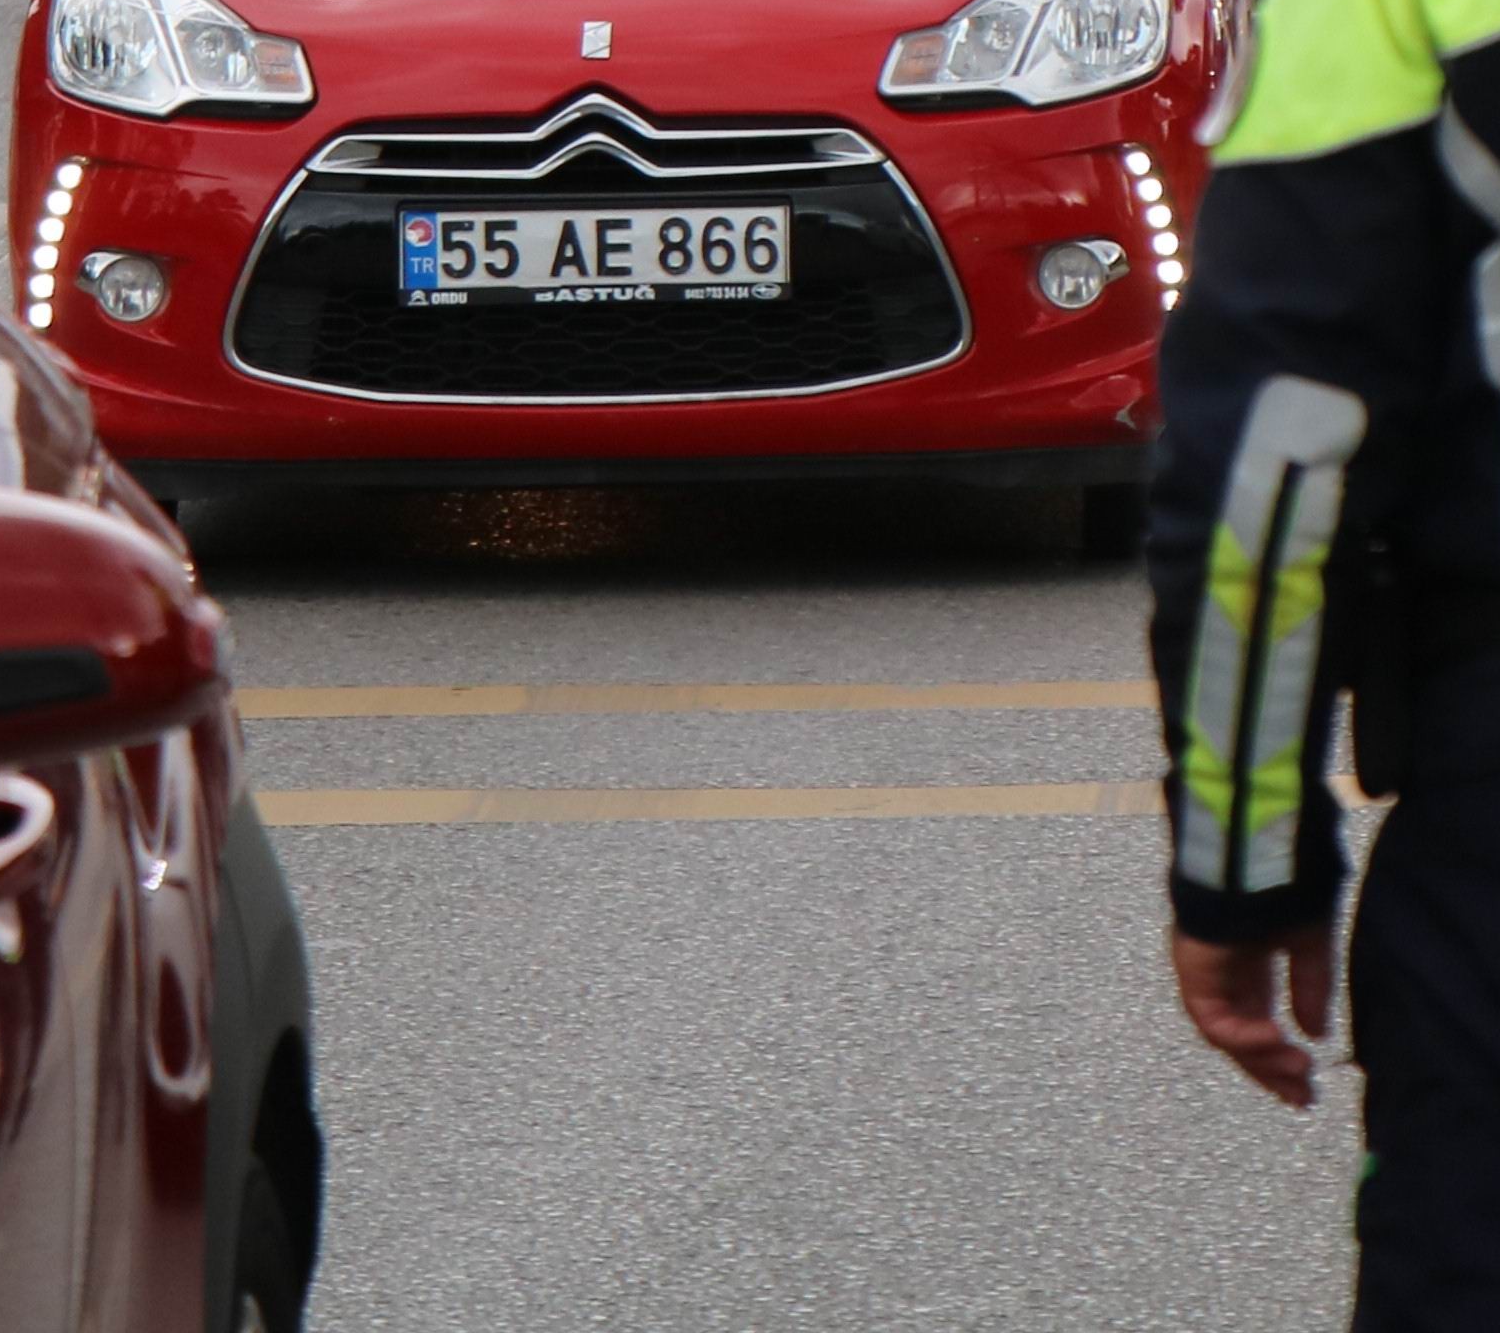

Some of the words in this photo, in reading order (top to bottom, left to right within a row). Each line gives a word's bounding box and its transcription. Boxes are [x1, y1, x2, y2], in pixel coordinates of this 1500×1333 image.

[441, 219, 520, 279] 55
[550, 218, 633, 278] AE
[658, 216, 779, 276] 866
[411, 257, 436, 274] TR
[431, 291, 468, 304] ORDU
